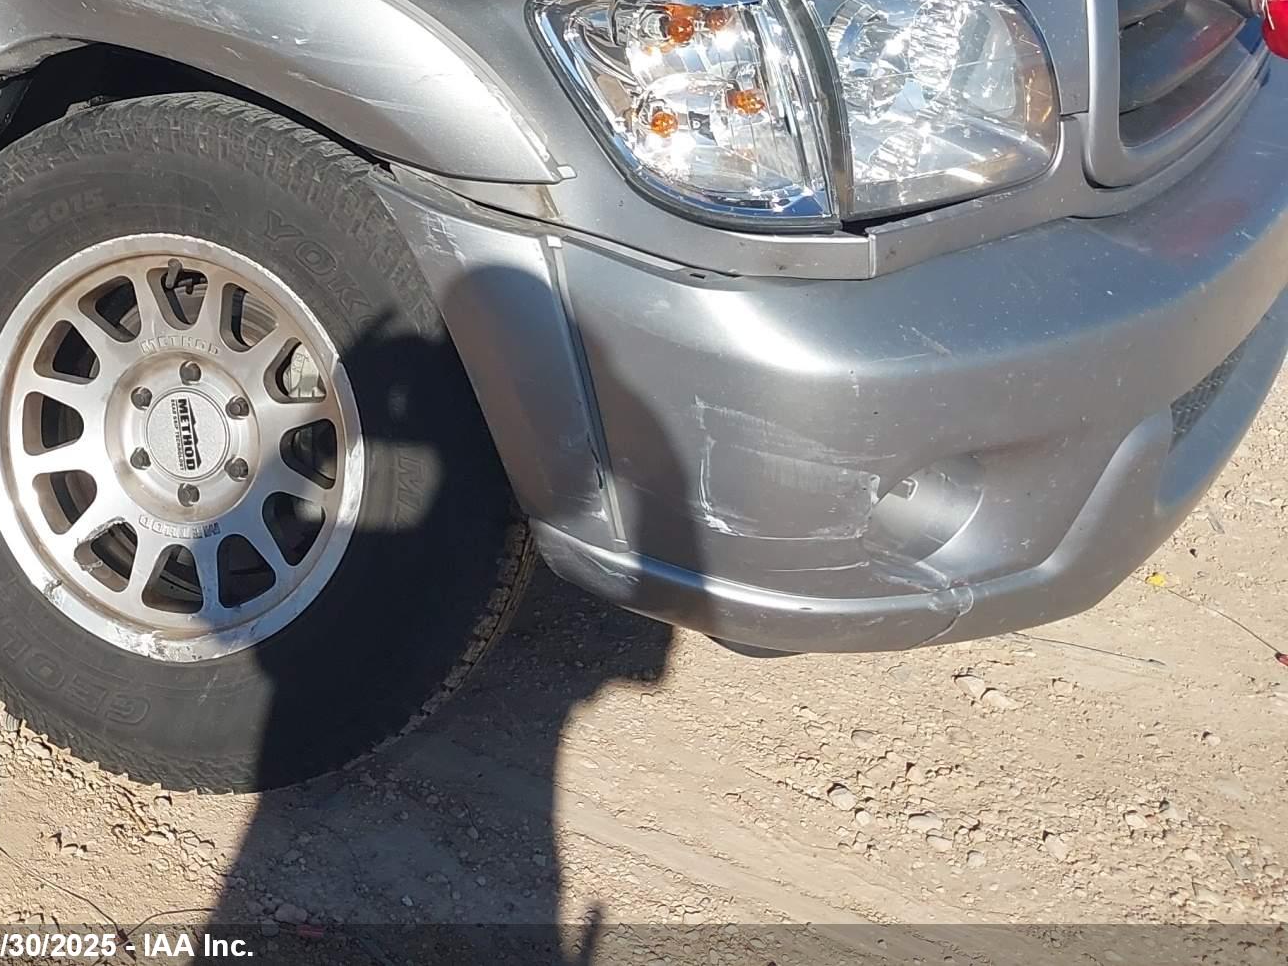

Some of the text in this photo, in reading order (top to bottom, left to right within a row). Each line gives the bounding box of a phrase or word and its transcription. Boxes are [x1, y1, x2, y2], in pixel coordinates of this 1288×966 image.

[140, 334, 220, 355] METHOD
[176, 397, 196, 471] METHOD
[138, 514, 221, 539] METHOD
